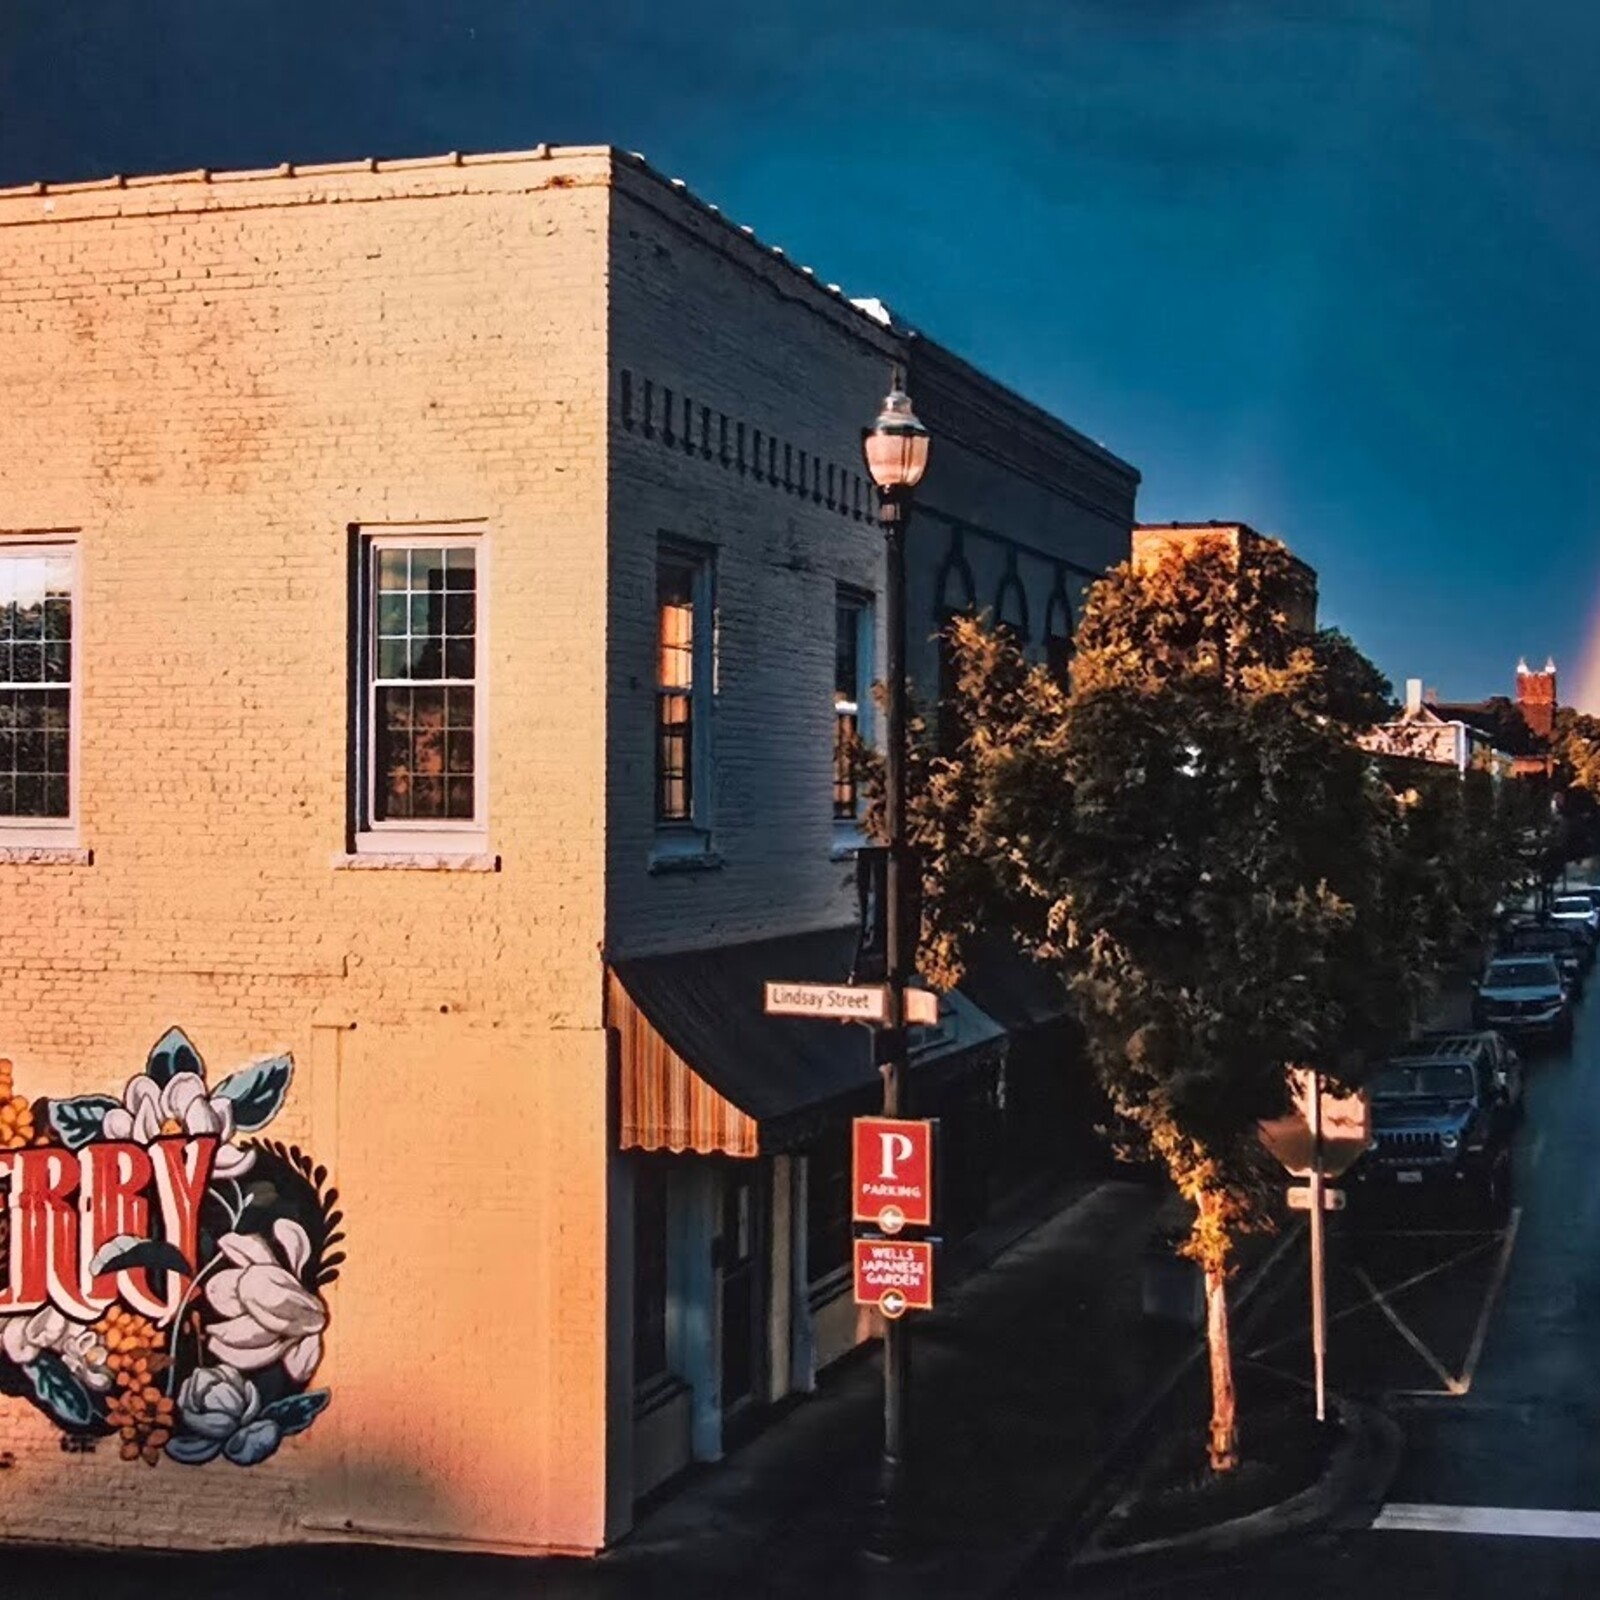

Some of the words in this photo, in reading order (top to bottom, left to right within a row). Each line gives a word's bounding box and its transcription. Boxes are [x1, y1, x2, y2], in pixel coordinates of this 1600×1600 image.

[772, 987, 824, 1008] Lindsay
[827, 990, 870, 1009] Street
[878, 1132, 913, 1179] P
[862, 1183, 921, 1199] PARKING
[0, 1137, 217, 1318] RRY
[871, 1247, 914, 1261] WELLS
[862, 1259, 925, 1275] JAPANESE
[865, 1272, 920, 1287] GARDEN
